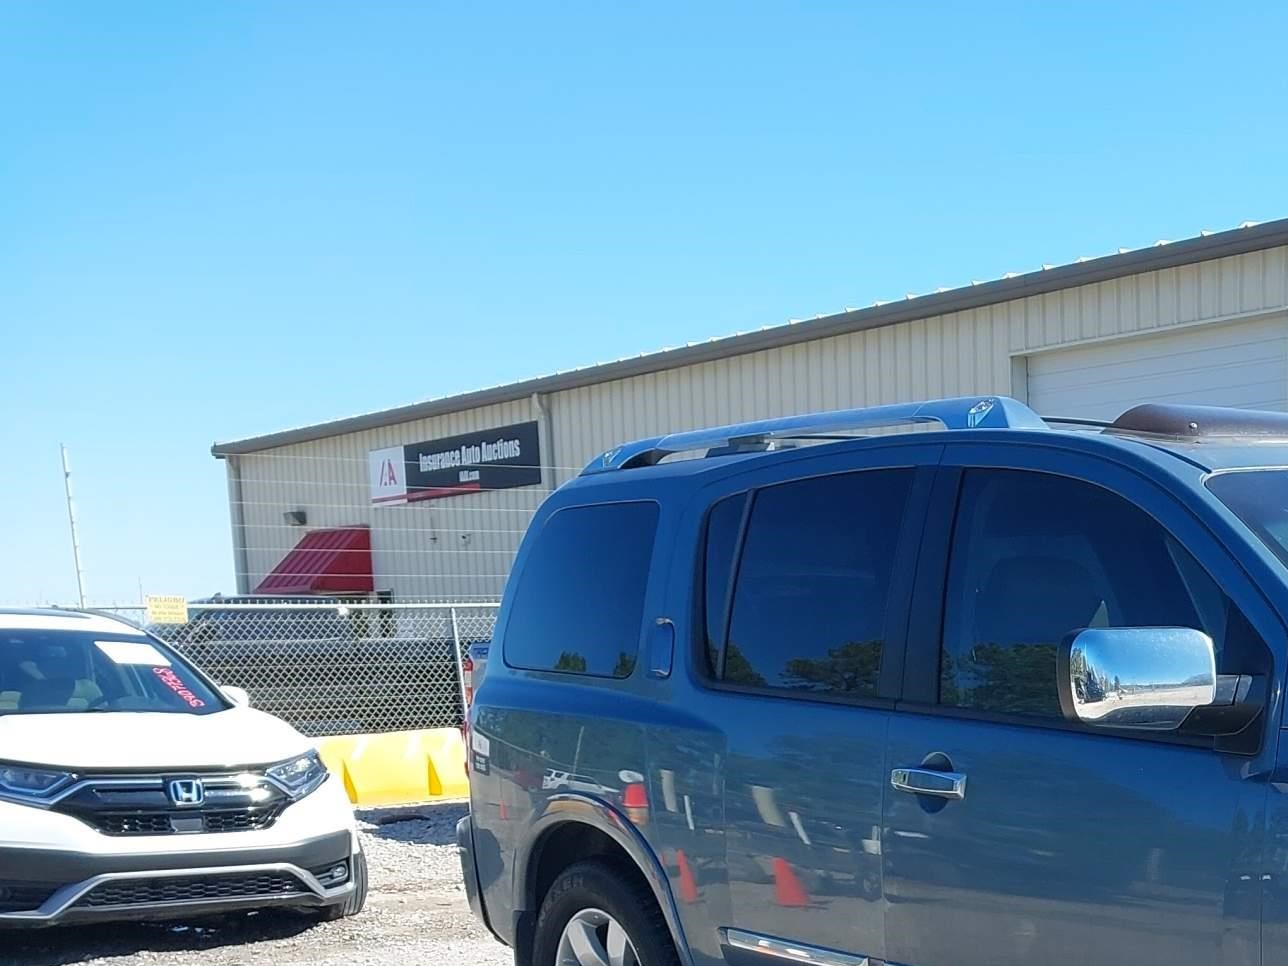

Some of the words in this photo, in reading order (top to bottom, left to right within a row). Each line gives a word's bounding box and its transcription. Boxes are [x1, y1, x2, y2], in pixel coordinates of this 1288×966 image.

[420, 449, 460, 472] Insurance
[461, 445, 481, 465] Auto
[481, 438, 520, 462] Auctions
